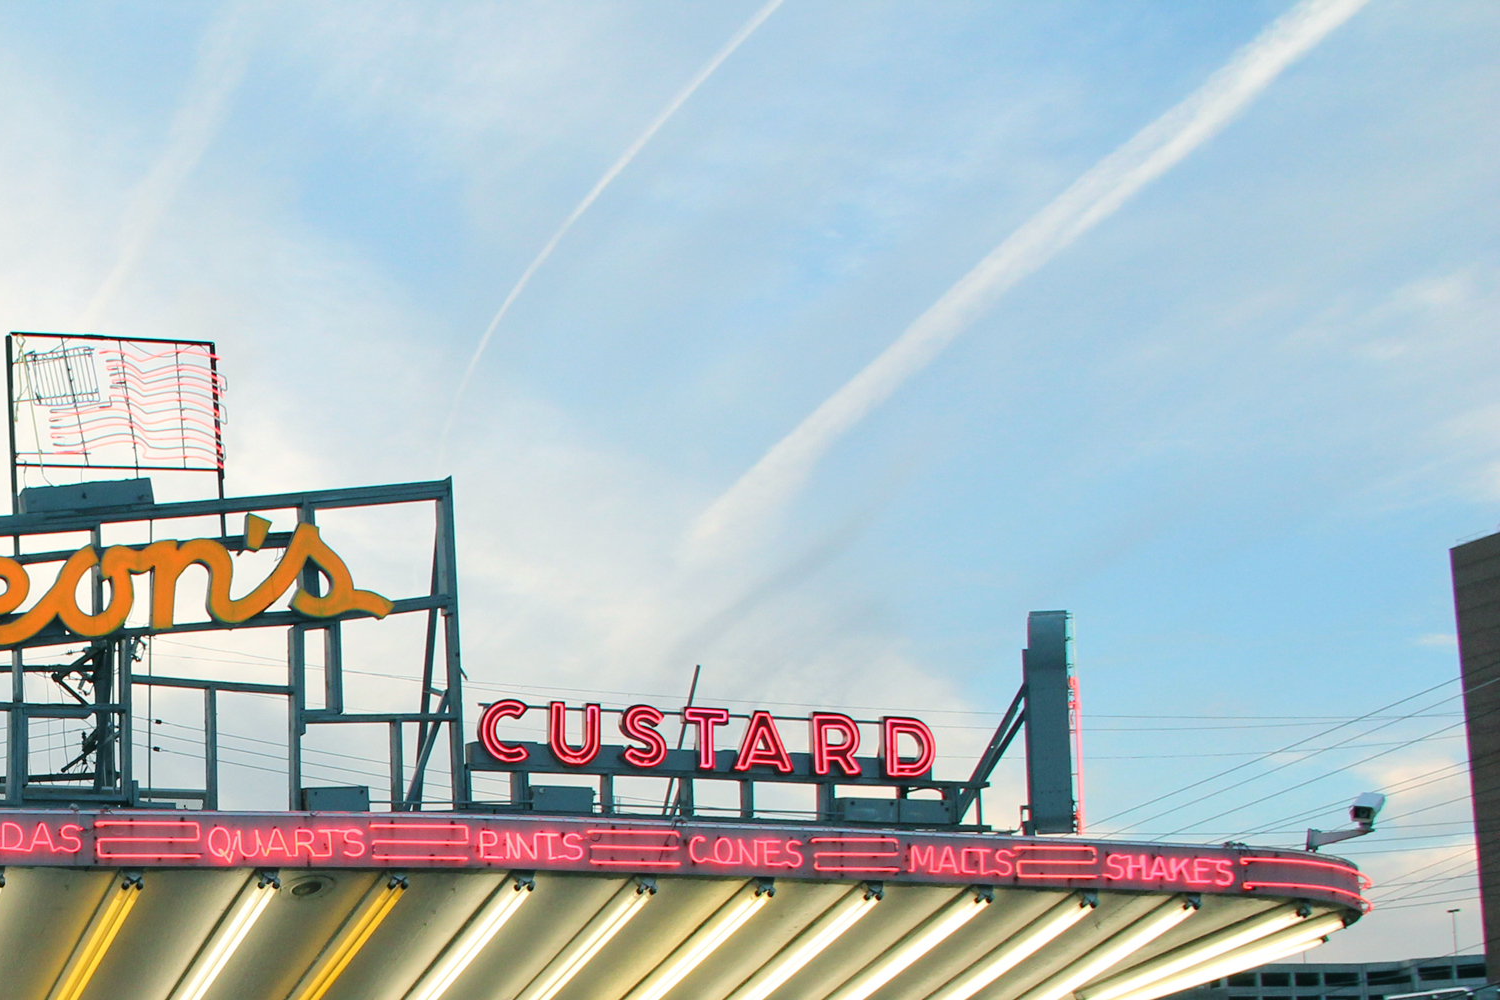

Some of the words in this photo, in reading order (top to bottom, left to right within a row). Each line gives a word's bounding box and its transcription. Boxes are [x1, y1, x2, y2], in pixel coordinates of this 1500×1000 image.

[479, 699, 937, 778] CUSTARD
[206, 824, 367, 866] QUARTS
[476, 829, 586, 862] PINTS
[687, 834, 805, 868] CONES
[906, 844, 1016, 877] MALTS
[1103, 852, 1236, 888] SHAKES
